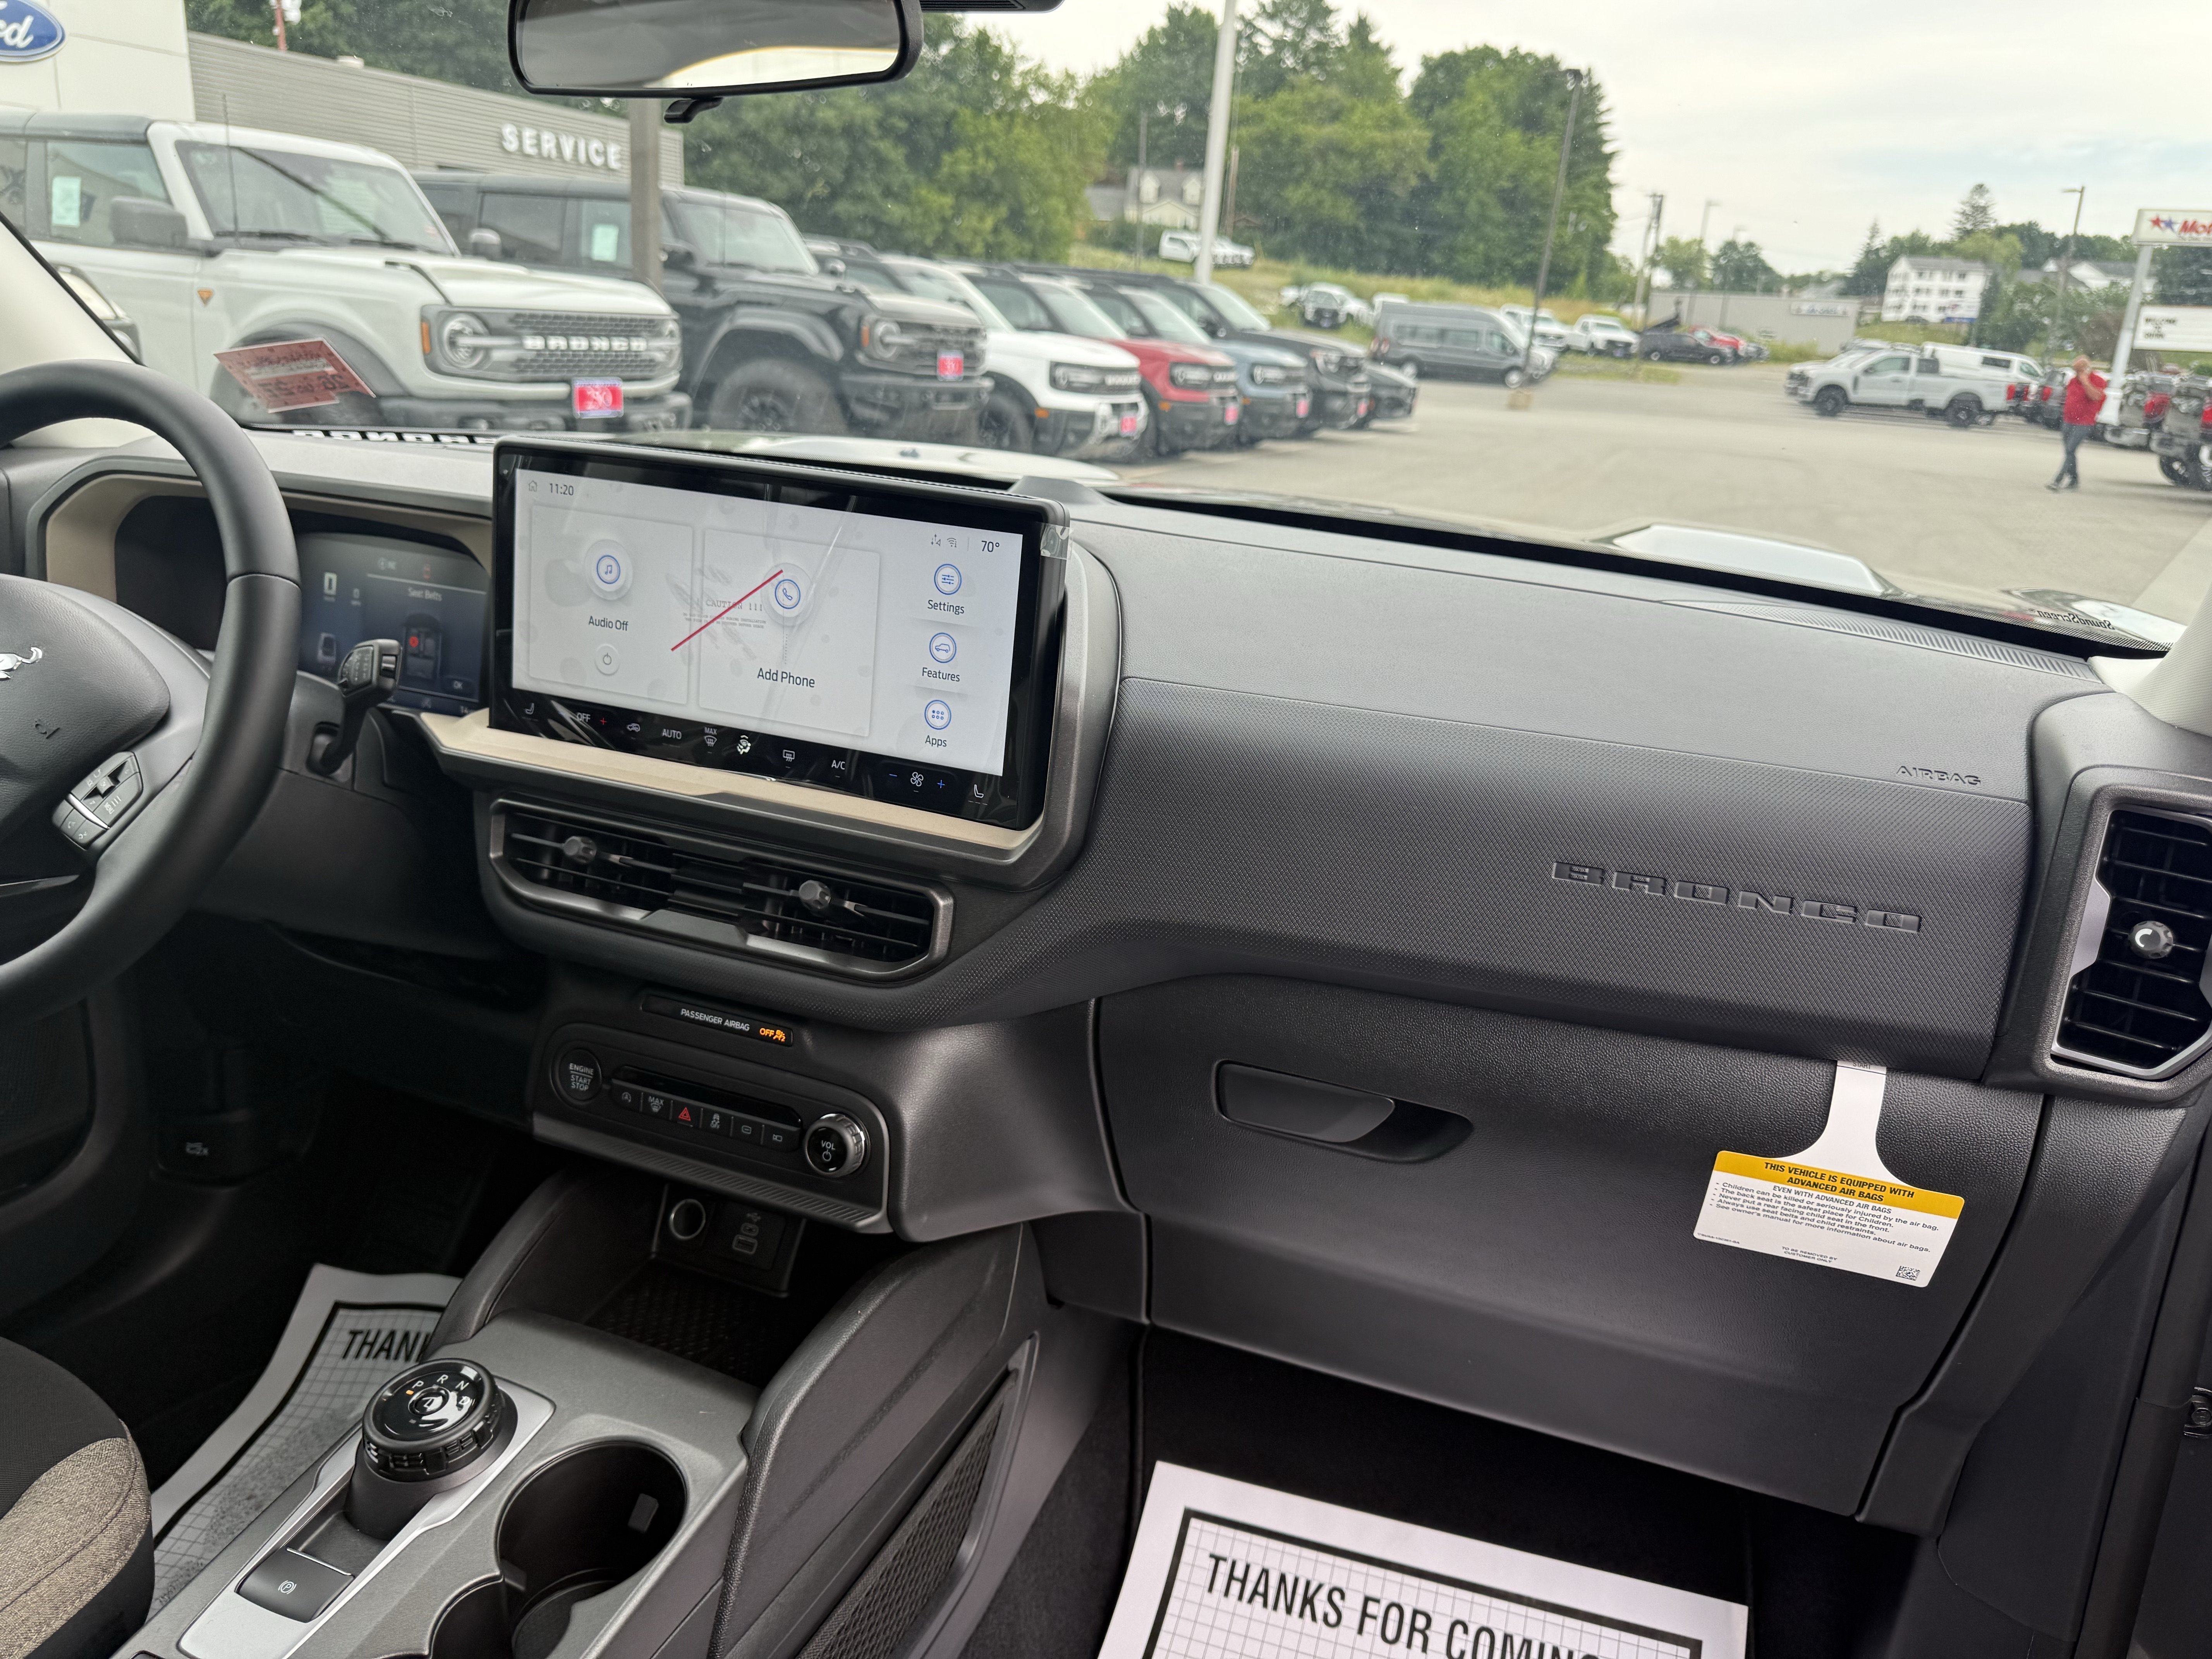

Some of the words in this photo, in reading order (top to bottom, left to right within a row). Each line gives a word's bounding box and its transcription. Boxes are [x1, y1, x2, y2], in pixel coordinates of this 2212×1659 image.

[501, 123, 622, 170] SERVICE
[549, 483, 574, 496] 11:20
[927, 599, 965, 615] Settings
[588, 615, 613, 629] Audio
[615, 620, 629, 631] Off
[757, 667, 778, 683] Add
[781, 671, 815, 688] Phone
[922, 667, 960, 682] Features
[577, 712, 591, 723] OFF
[662, 728, 682, 740] AUTO
[704, 727, 717, 735] MAX
[925, 735, 947, 747] Apps
[831, 760, 845, 771] A/C
[1896, 765, 1981, 785] AIRBAG
[1552, 861, 1922, 933] BRONCO
[681, 1008, 723, 1025] PASSENGER
[724, 1019, 750, 1031] AIRBAG
[759, 1028, 774, 1037] OFF
[569, 1063, 594, 1075] ENGINE
[570, 1074, 591, 1085] START
[571, 1082, 589, 1091] STOP
[648, 1096, 664, 1106] MAX
[821, 1140, 836, 1151] VOL
[1764, 1162, 1785, 1172] THIS
[1788, 1166, 1826, 1180] VEHICLE
[1840, 1177, 1887, 1192] EQUIPPED
[1889, 1187, 1915, 1198] WITH
[1786, 1177, 1837, 1192] ADVANCED
[1839, 1187, 1855, 1196] AIR
[1858, 1191, 1884, 1202] BAGS
[1723, 1182, 1754, 1193] Children
[1783, 1194, 1804, 1203] killed
[1816, 1202, 1852, 1213] seriously
[1854, 1209, 1881, 1219] injured
[1922, 1223, 1939, 1231] bag.
[1773, 1185, 1792, 1194] EVEN
[1794, 1190, 1814, 1198] WITH
[1815, 1194, 1854, 1207] ADVANCED
[1871, 1206, 1892, 1214] BAGS
[1717, 1199, 1744, 1209] Always
[1816, 1219, 1836, 1227] child
[1837, 1224, 1876, 1235] restraints.
[1718, 1193, 1741, 1202] Never
[1781, 1206, 1804, 1216] facing
[1869, 1224, 1890, 1233] front.
[1797, 1204, 1820, 1212] safest
[1822, 1209, 1843, 1218] place
[1858, 1216, 1893, 1228] Children.
[1731, 1207, 1761, 1217] owner's
[1763, 1214, 1791, 1223] manual
[1827, 1225, 1871, 1240] information
[1873, 1237, 1896, 1245] about
[1909, 1244, 1930, 1252] bags.
[1784, 1250, 1815, 1260] CUSTOMER
[1800, 1250, 1828, 1259] REMOVED
[412, 1380, 424, 1389] P
[436, 1374, 449, 1384] R
[455, 1380, 470, 1391] N
[1207, 1553, 1345, 1628] THANKS
[1357, 1595, 1432, 1654] FOR
[1446, 1619, 1600, 1659] COM
